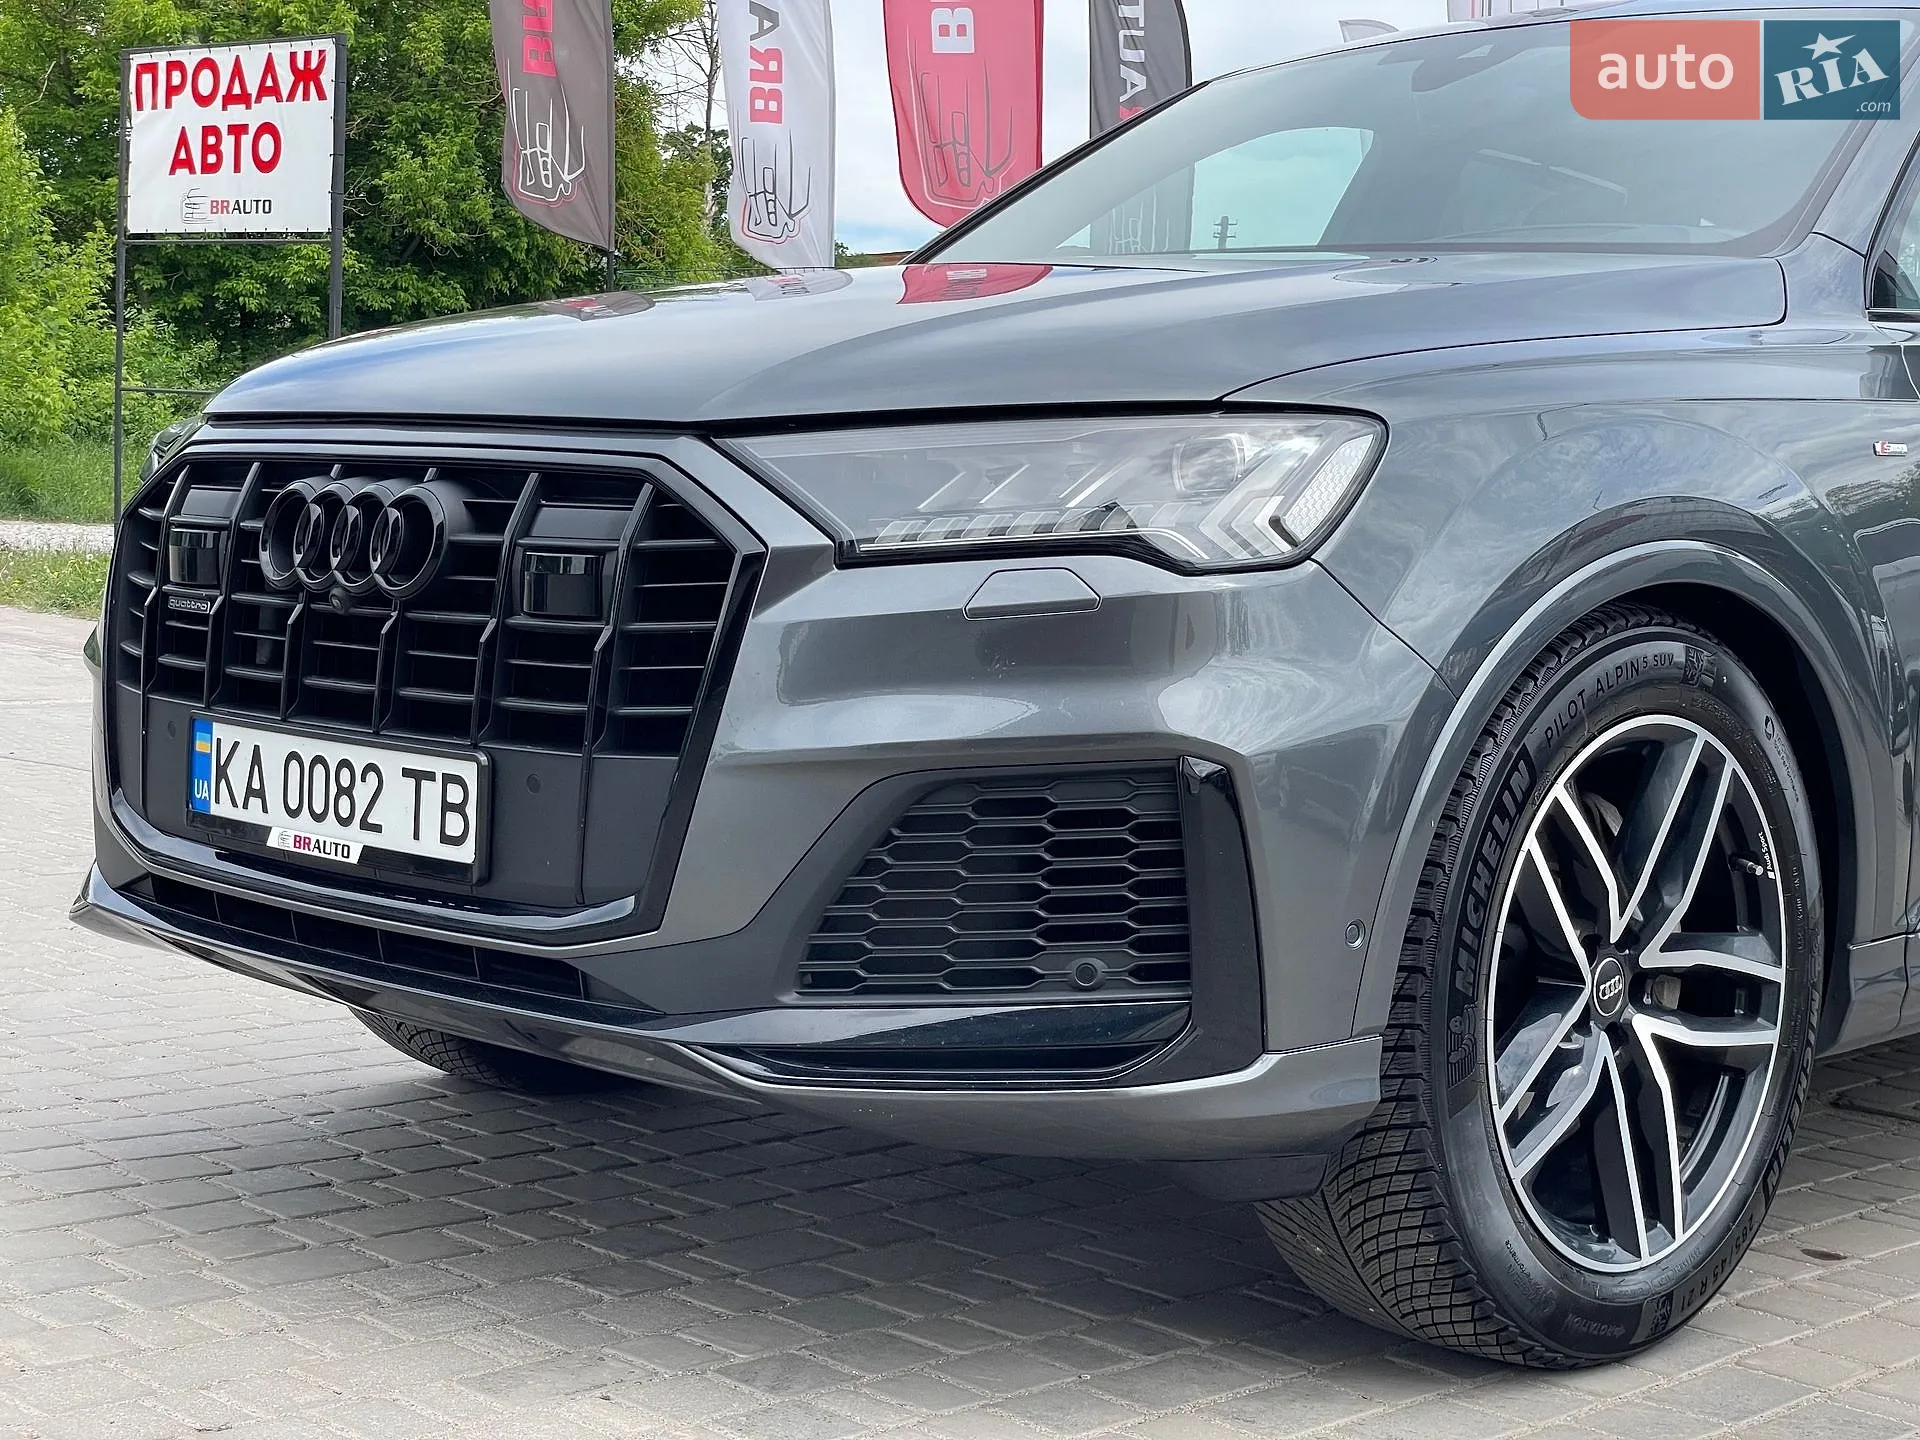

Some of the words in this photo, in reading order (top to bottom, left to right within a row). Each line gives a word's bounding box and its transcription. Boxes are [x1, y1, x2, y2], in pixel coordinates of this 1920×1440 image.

[135, 49, 328, 111] ПРОДАЖ
[168, 121, 282, 176] АВТО
[209, 198, 272, 215] BRAUTO
[169, 599, 207, 610] quattro
[1544, 688, 1586, 748] PILOT
[1653, 652, 1674, 667] SUV
[195, 779, 210, 799] UA
[214, 738, 269, 813] KA
[282, 750, 384, 834] 0082
[401, 767, 470, 847] TB
[293, 834, 350, 859] BRAUTO
[1455, 759, 1531, 997] MICHELIN
